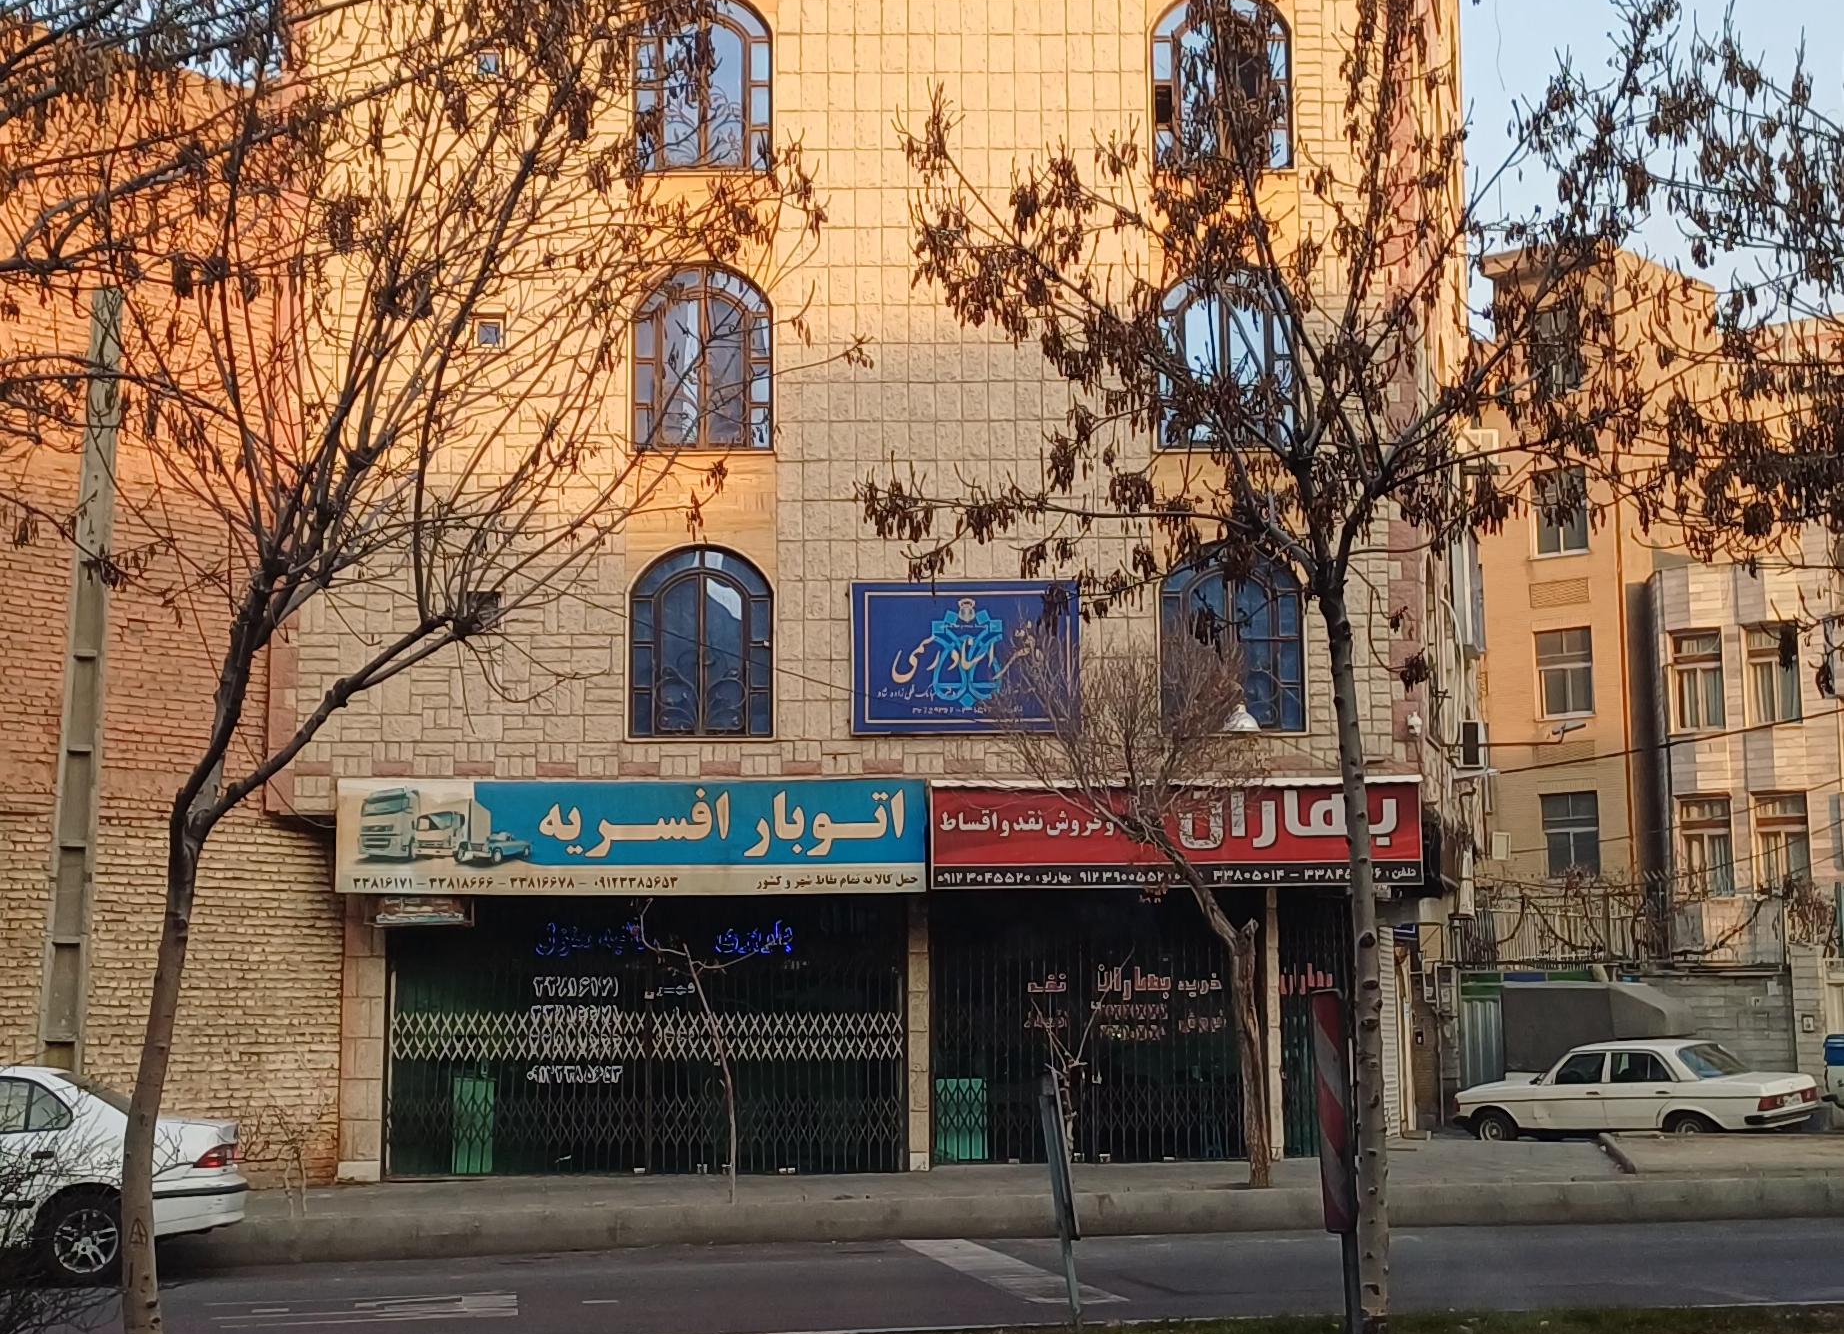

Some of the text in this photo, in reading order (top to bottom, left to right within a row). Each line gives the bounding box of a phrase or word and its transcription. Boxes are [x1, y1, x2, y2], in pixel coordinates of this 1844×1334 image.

[891, 633, 941, 684] رسمی
[947, 637, 996, 672] اسناد
[537, 786, 907, 858] اتوبار افسریه
[939, 810, 998, 832] اقساط
[999, 820, 1010, 837] و
[1013, 810, 1044, 832] نقد
[1045, 808, 1103, 837] فروش
[756, 875, 783, 890] کشور
[793, 874, 813, 889] شهر
[815, 874, 837, 885] نقاط
[839, 874, 861, 888] تمام
[876, 873, 893, 885] کالا
[895, 874, 918, 887] حمل
[1212, 868, 1286, 882] ۳۳۸۰۵۰۱۴
